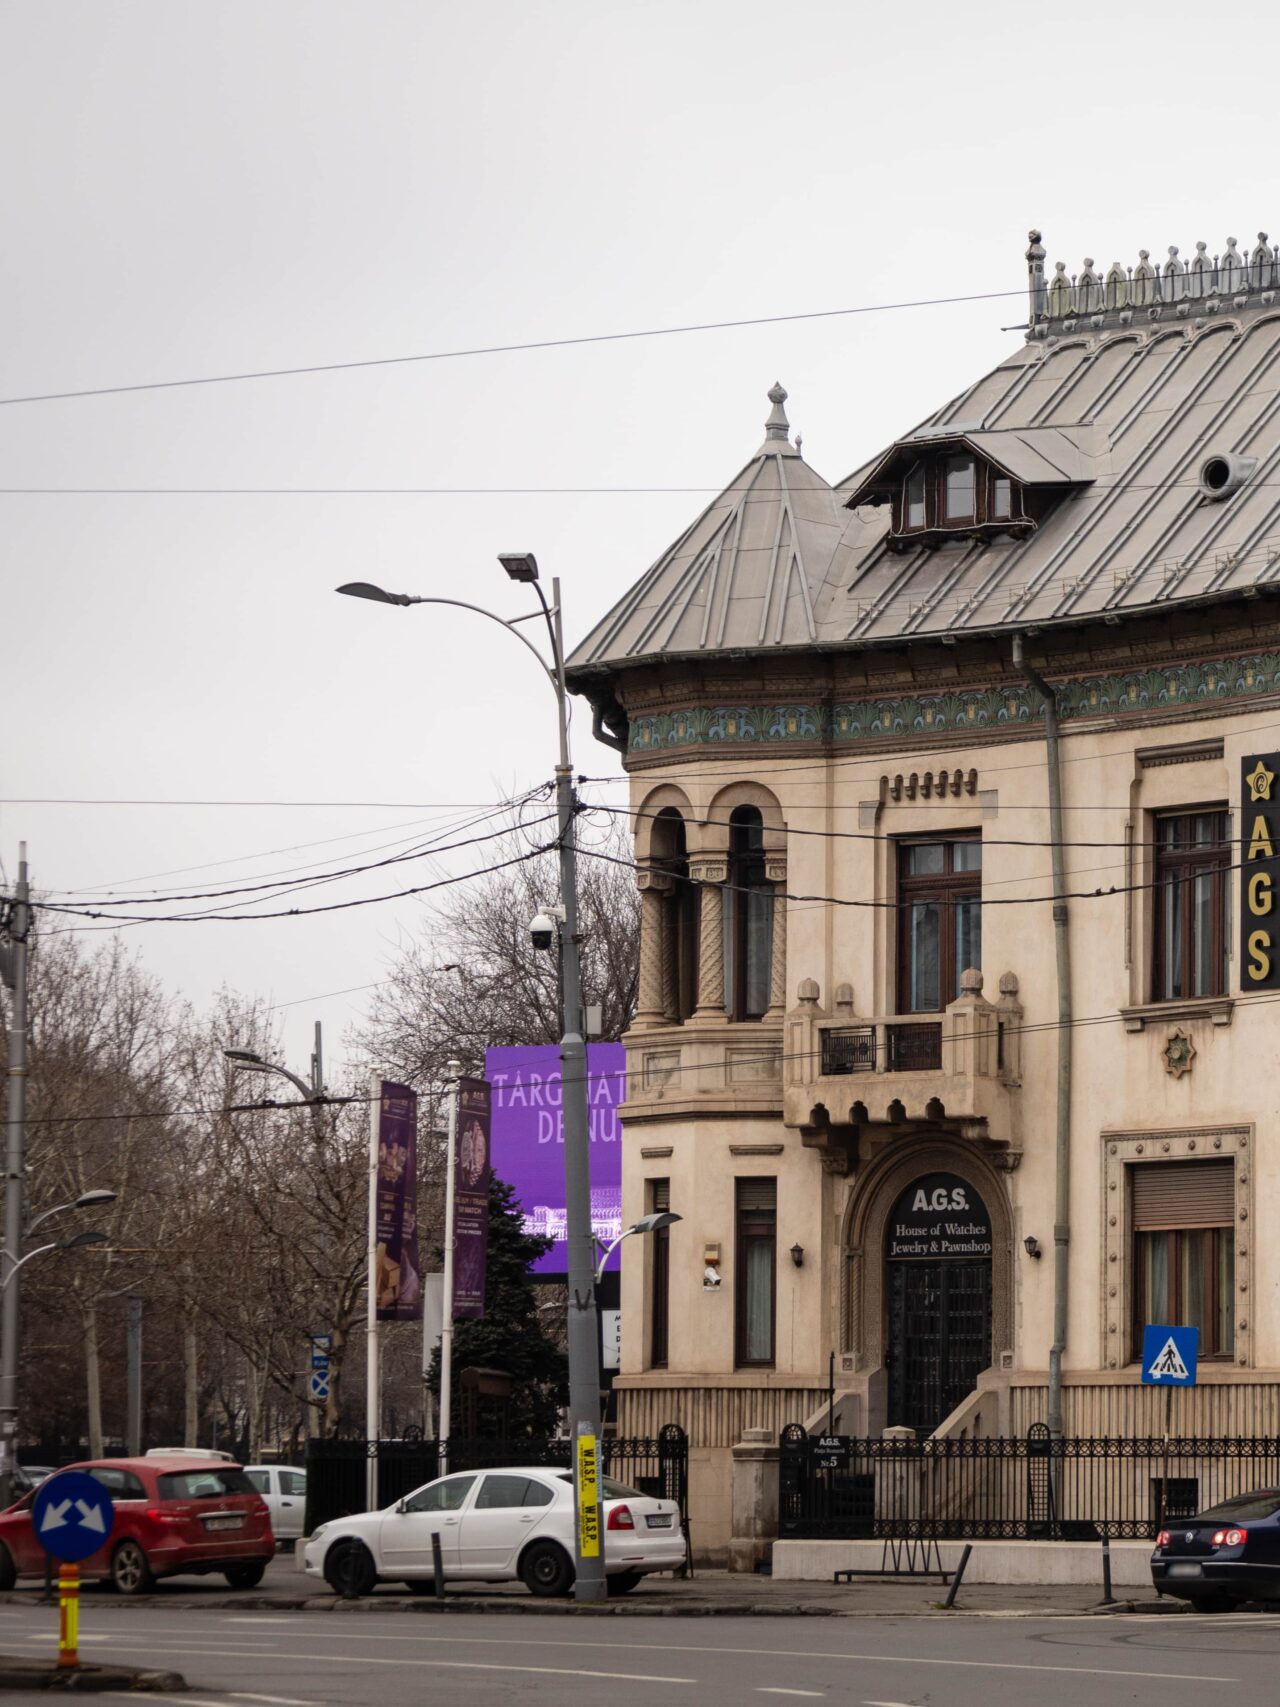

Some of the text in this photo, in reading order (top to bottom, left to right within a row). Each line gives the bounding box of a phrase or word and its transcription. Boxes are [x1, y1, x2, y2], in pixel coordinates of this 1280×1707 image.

[1247, 815, 1274, 981] AGS
[912, 1188, 970, 1211] A.G.S.
[896, 1223, 986, 1236] House of Watches
[891, 1240, 991, 1255] Jewelry & Pawnshop
